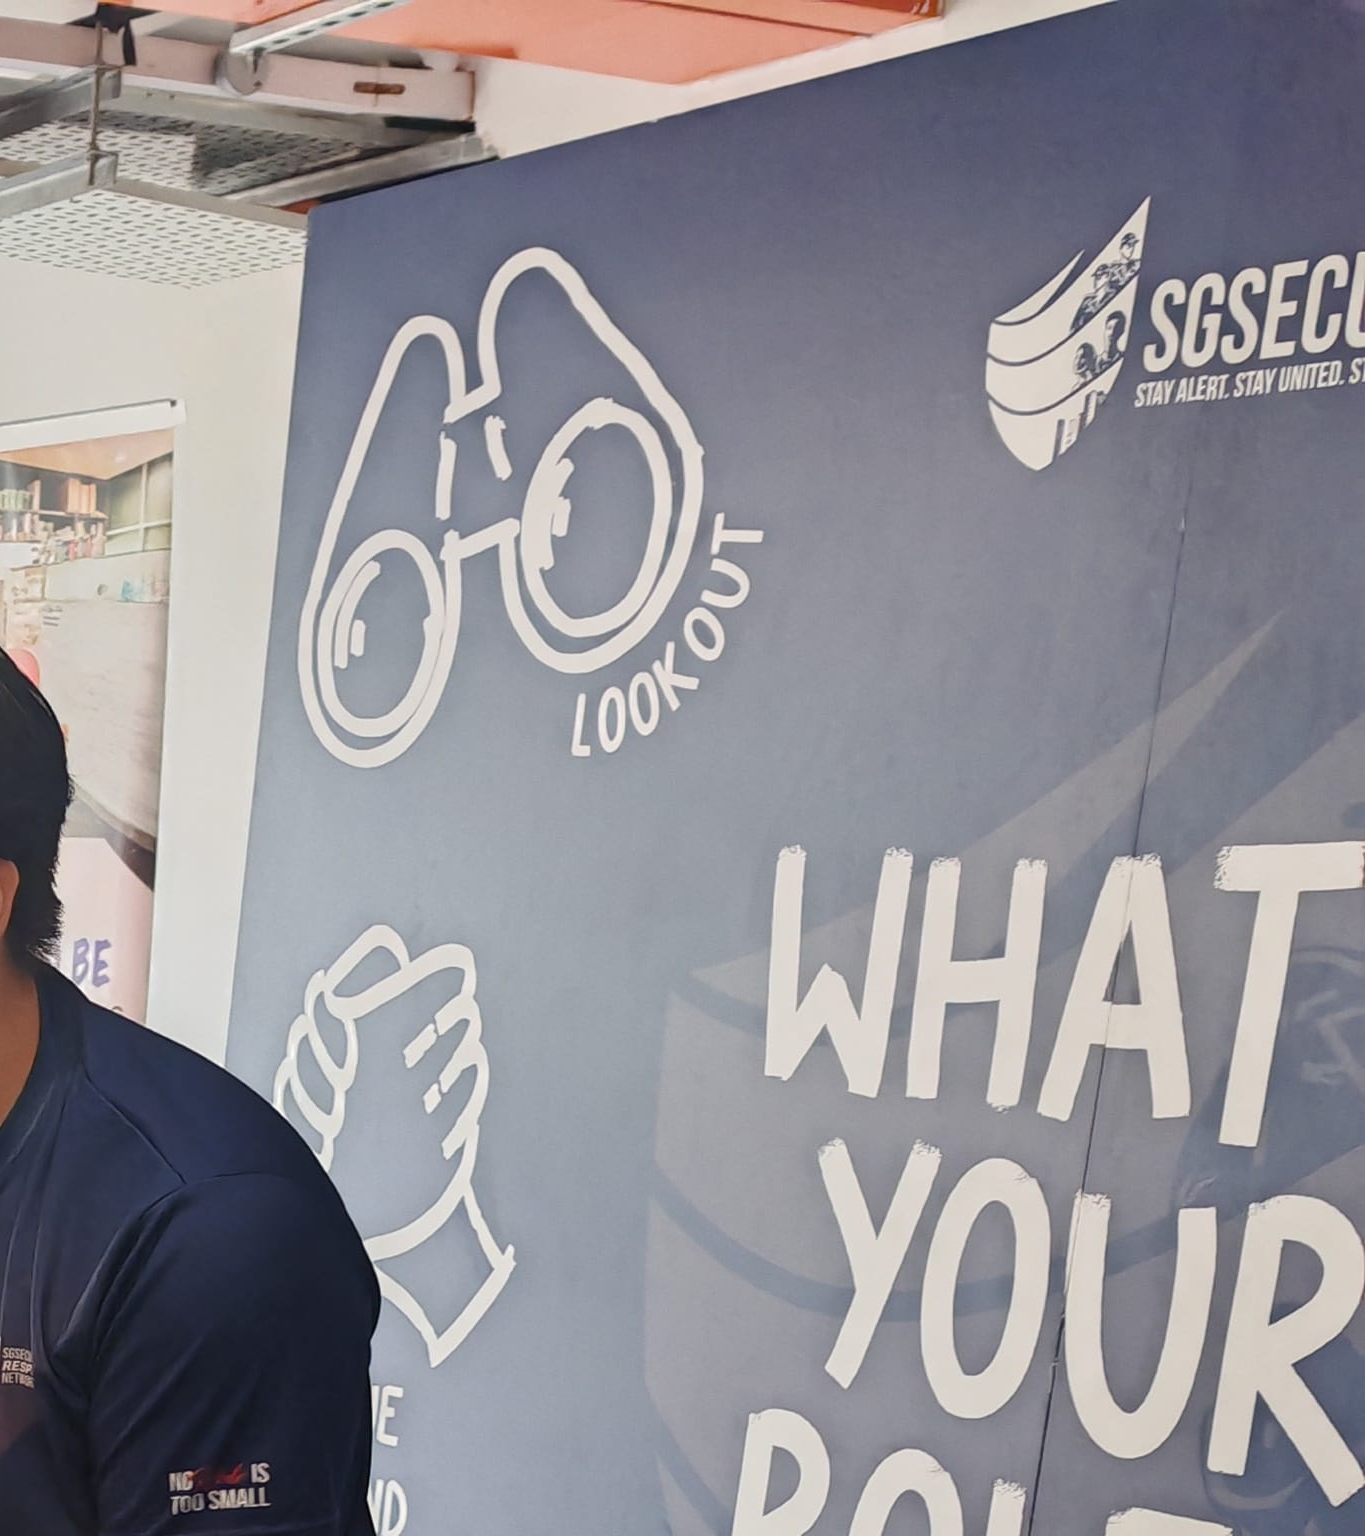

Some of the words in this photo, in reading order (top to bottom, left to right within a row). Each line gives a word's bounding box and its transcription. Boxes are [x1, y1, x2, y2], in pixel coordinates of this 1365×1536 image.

[1134, 378, 1176, 408] STAY
[1175, 373, 1230, 403] ALERT.
[1233, 366, 1278, 397] STAY
[1278, 359, 1345, 392] UNITED.
[72, 938, 111, 988] BE
[764, 841, 1365, 1147] WHAT
[816, 1137, 1365, 1507] YOUR
[2, 1360, 35, 1376] RESP
[251, 1462, 270, 1483] IS
[170, 1493, 205, 1515] TOO
[208, 1487, 272, 1510] SMALL
